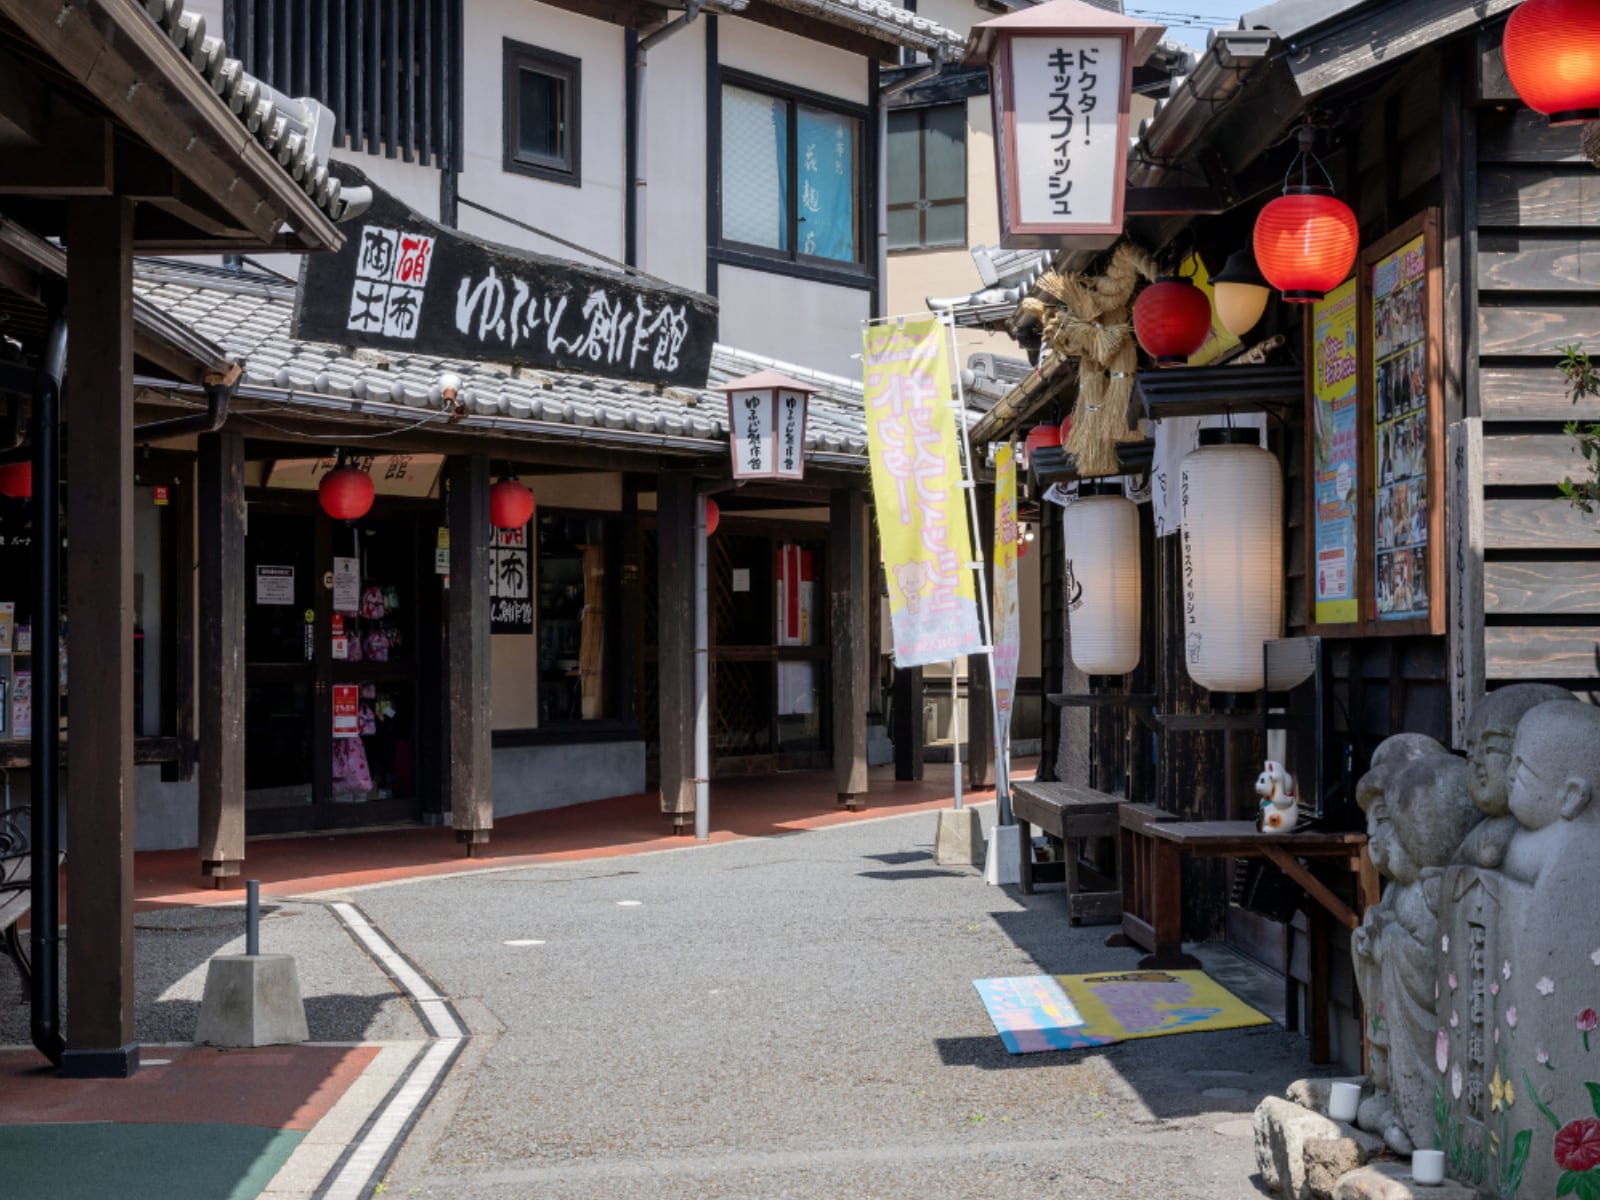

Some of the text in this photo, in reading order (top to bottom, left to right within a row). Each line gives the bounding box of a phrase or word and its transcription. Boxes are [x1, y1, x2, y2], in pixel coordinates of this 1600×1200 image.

[1047, 48, 1074, 215] キッスフィッシュ
[455, 266, 689, 373] ゆふいん創作館
